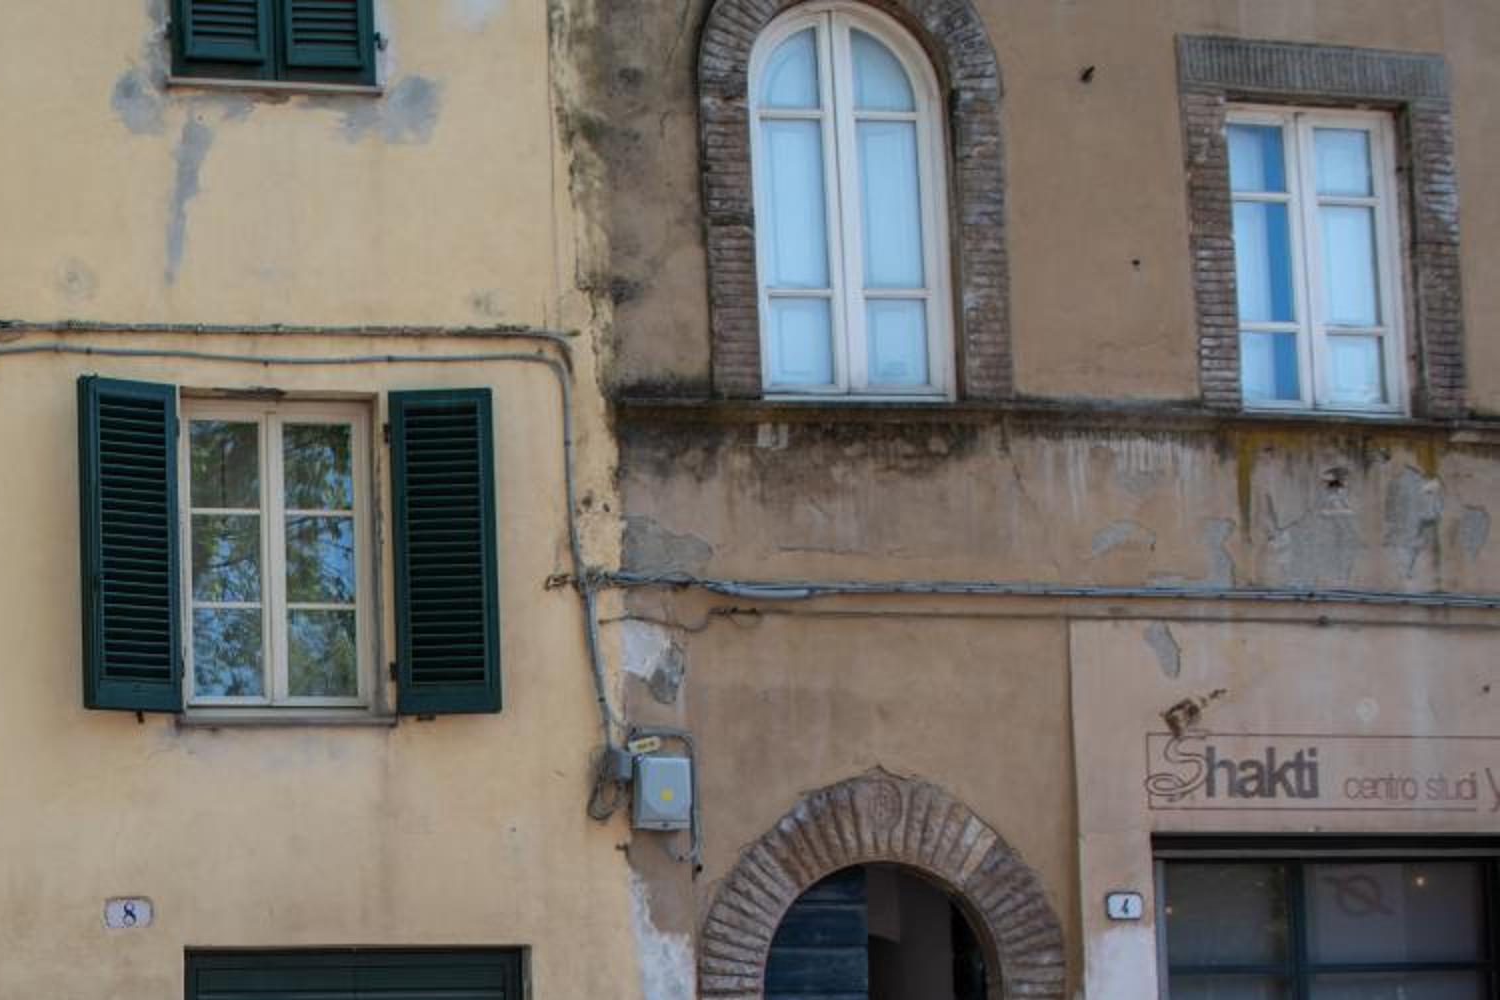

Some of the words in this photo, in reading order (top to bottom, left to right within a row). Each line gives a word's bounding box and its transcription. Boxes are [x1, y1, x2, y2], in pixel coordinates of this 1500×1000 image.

[1145, 735, 1319, 800] Shakti
[1345, 772, 1417, 800] centro
[123, 902, 136, 926] 8
